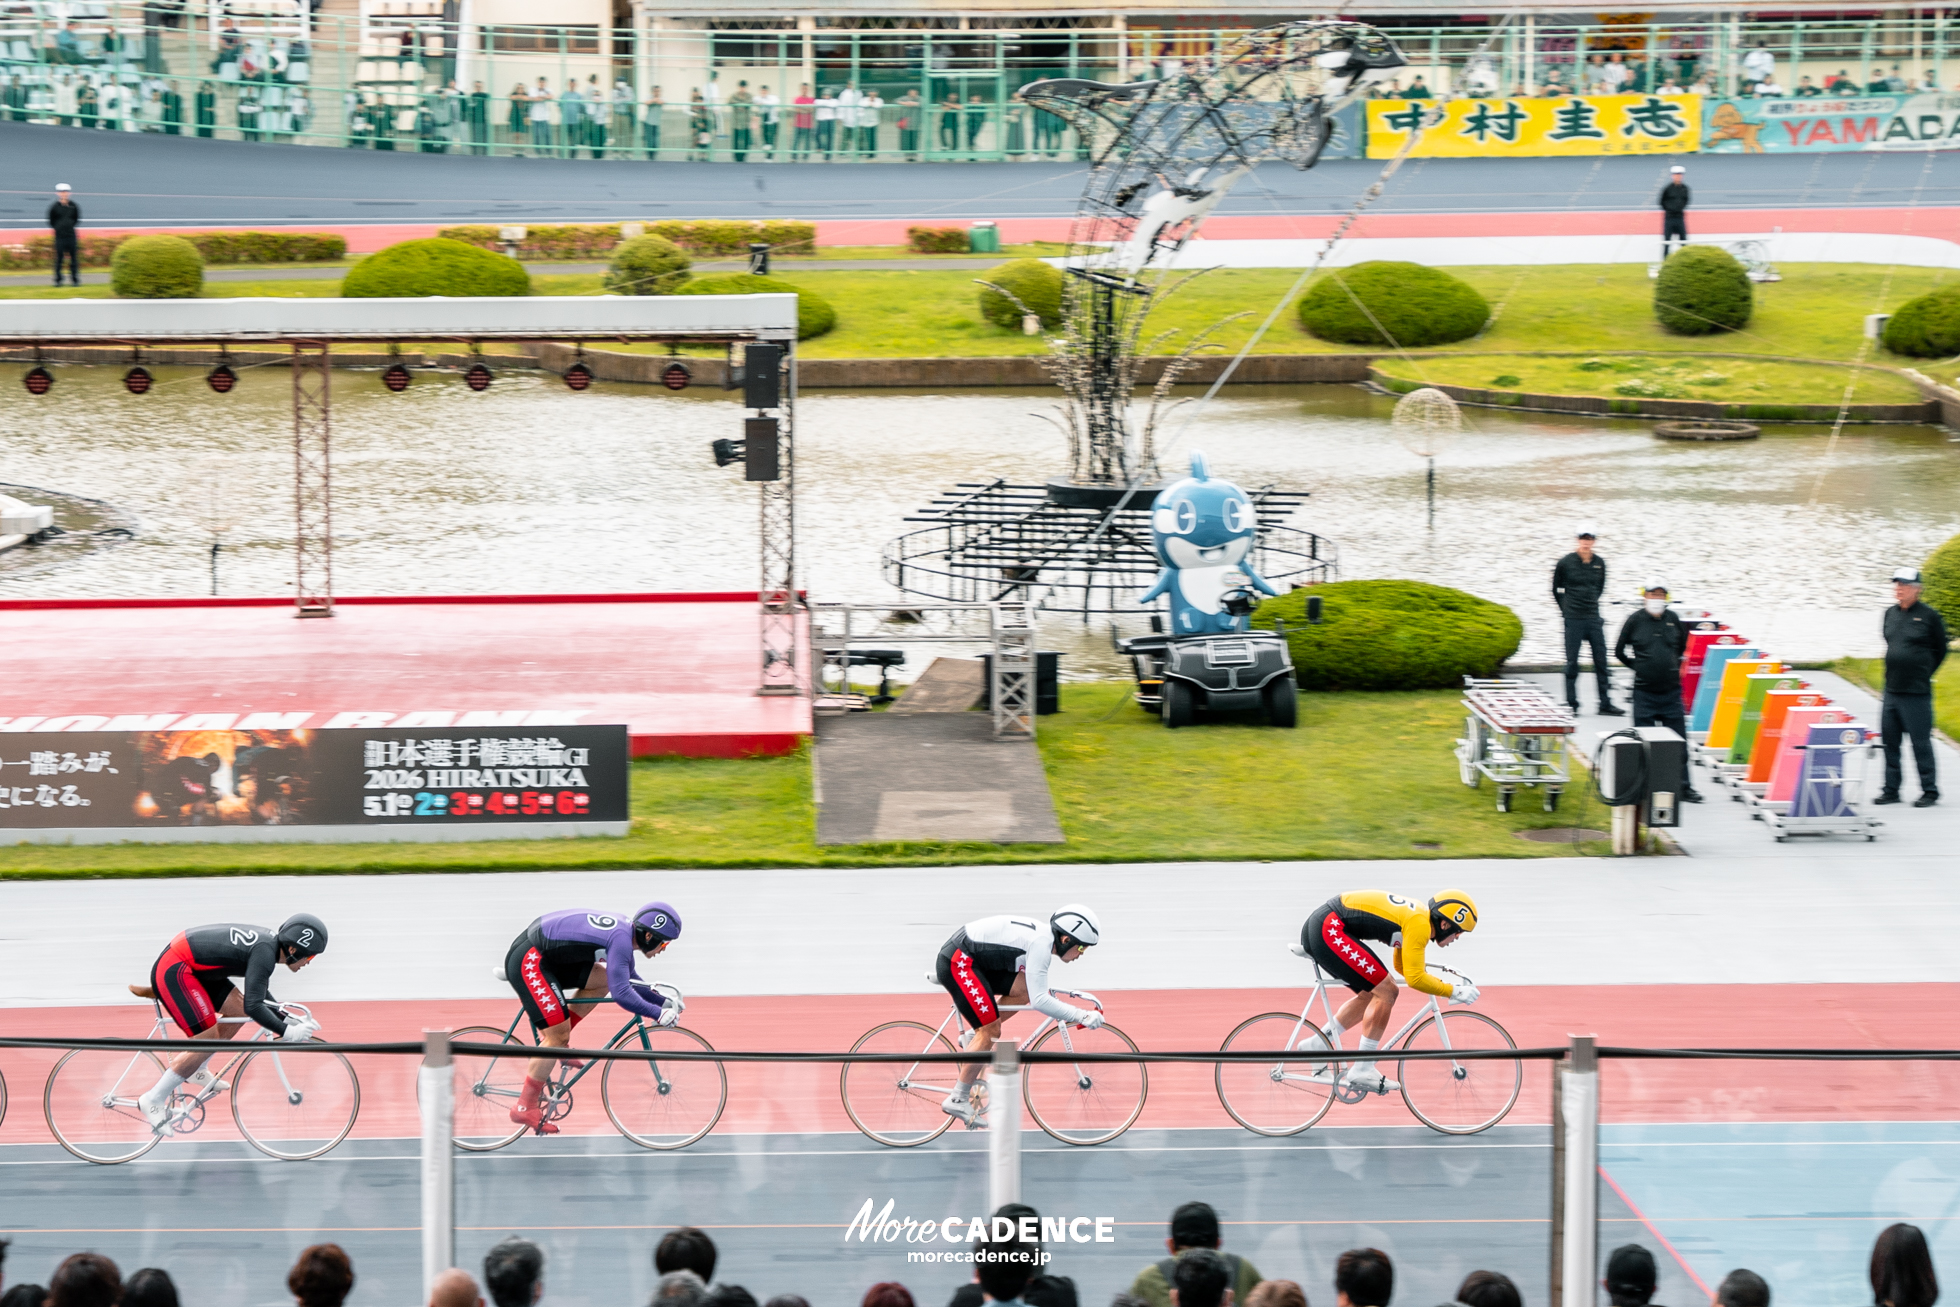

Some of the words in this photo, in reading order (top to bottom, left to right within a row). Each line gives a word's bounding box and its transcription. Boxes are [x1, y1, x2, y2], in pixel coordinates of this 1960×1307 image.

[1382, 97, 1687, 142] 中村圭志
[0, 750, 119, 776] 一踏みが、
[363, 769, 425, 789] 2026
[425, 767, 590, 787] HIRATSUKA
[586, 913, 618, 930] 9
[650, 913, 667, 930] 9
[1454, 907, 1469, 924] 5
[1010, 920, 1037, 931] 1
[1070, 920, 1084, 933] 1
[230, 926, 259, 946] 2
[296, 928, 315, 948] 2
